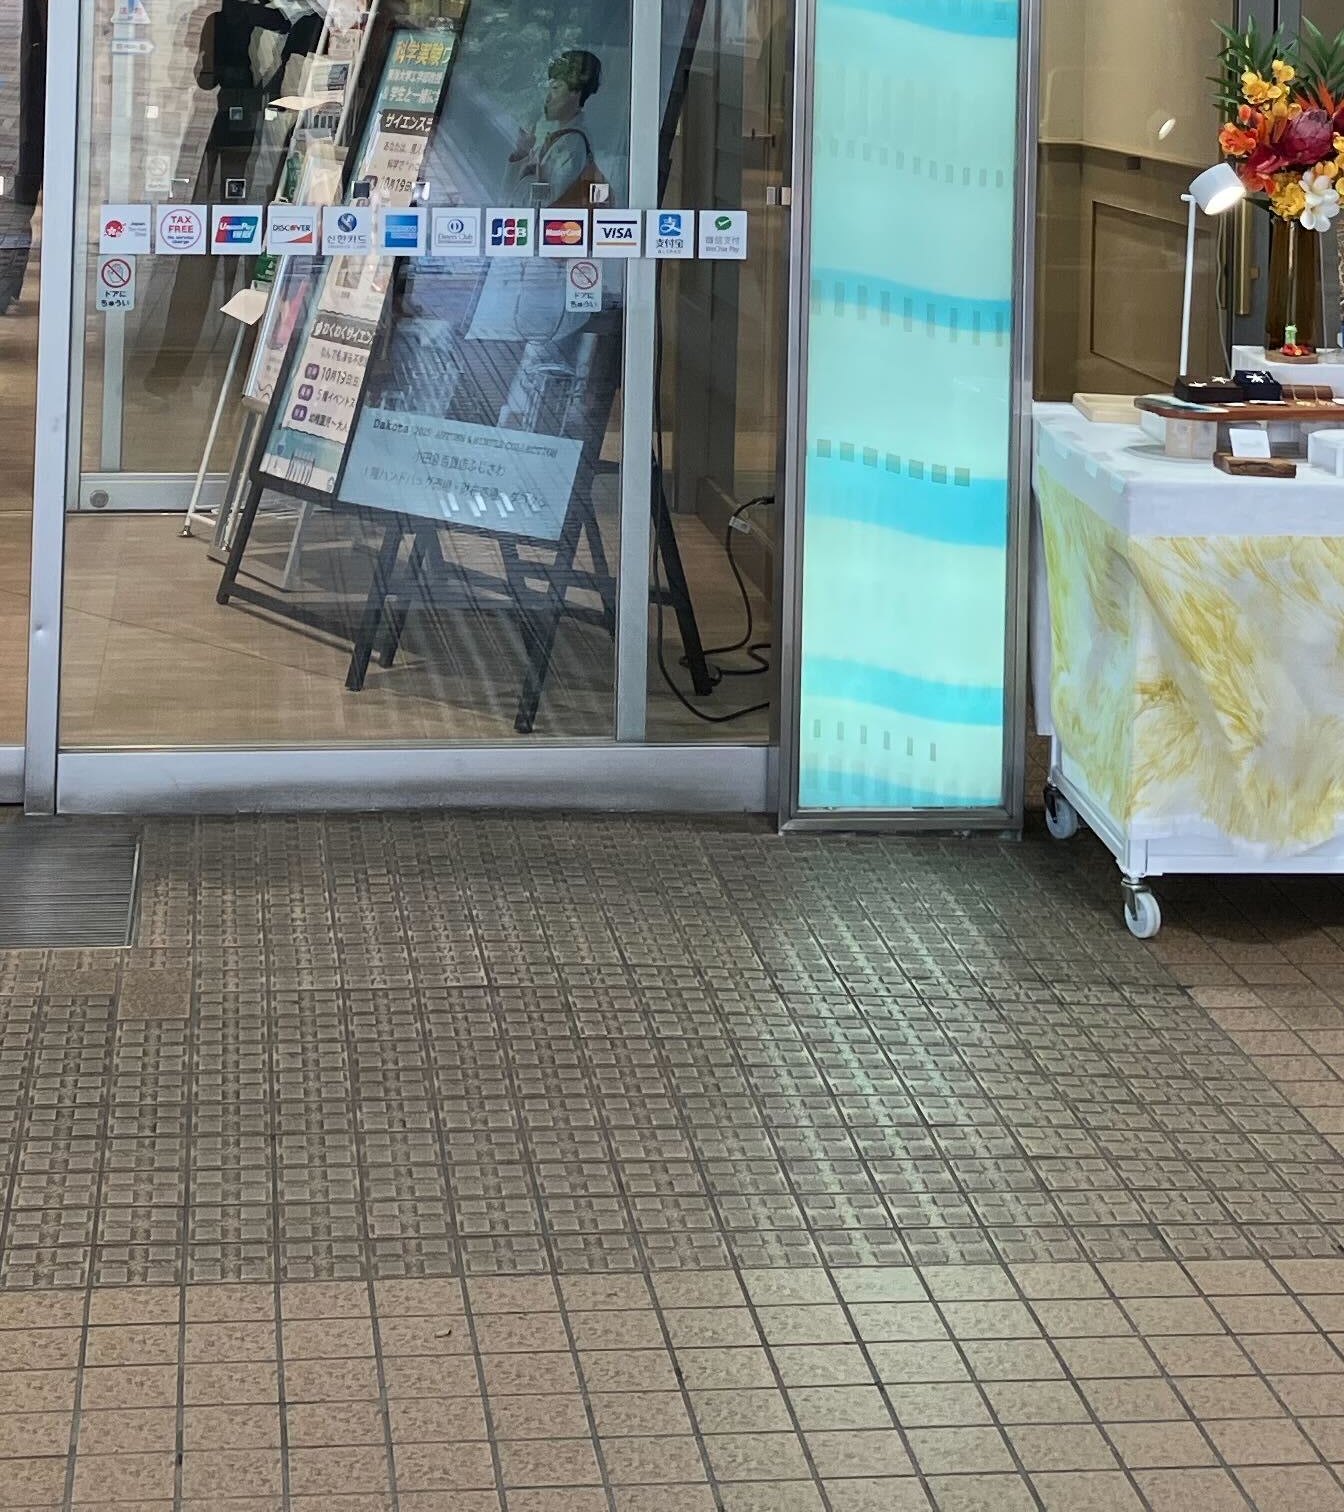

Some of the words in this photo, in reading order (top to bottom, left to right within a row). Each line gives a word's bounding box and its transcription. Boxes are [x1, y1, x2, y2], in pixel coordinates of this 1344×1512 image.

[170, 215, 192, 224] TAX
[168, 224, 194, 233] FREE
[272, 224, 311, 232] DISCOVER
[492, 226, 527, 238] JCB
[601, 227, 633, 239] VISA
[373, 418, 409, 434] Dakota
